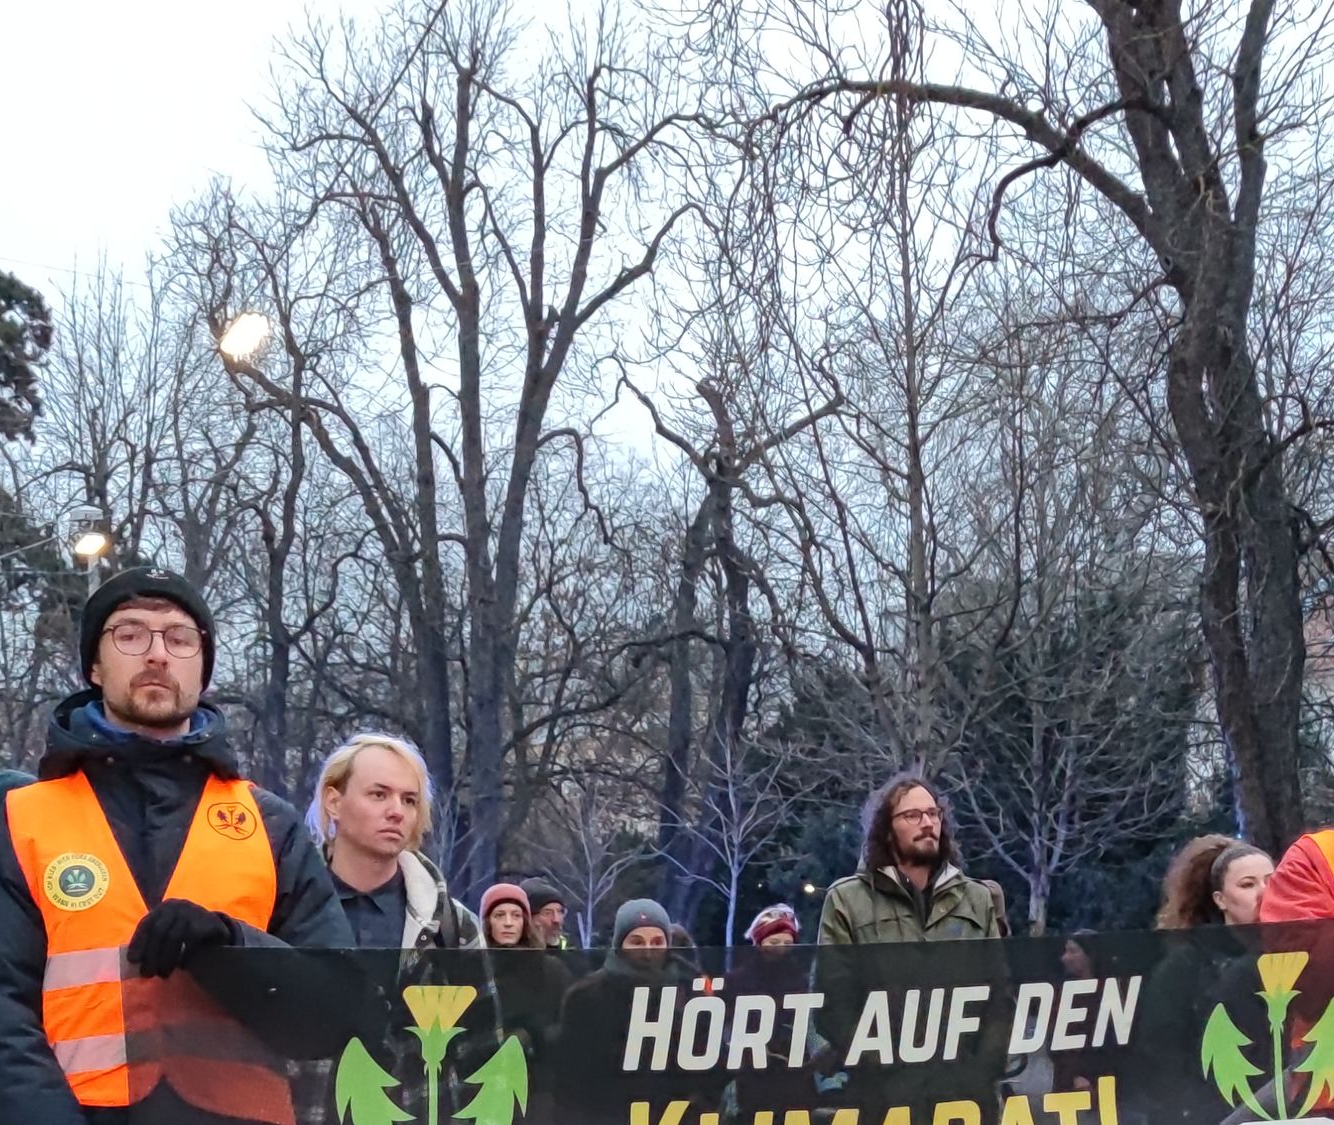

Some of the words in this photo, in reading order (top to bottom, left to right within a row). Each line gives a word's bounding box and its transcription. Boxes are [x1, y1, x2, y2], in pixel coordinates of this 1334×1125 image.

[622, 977, 824, 1071] HÖRT
[844, 985, 991, 1067] AUF
[1008, 975, 1142, 1055] DEN
